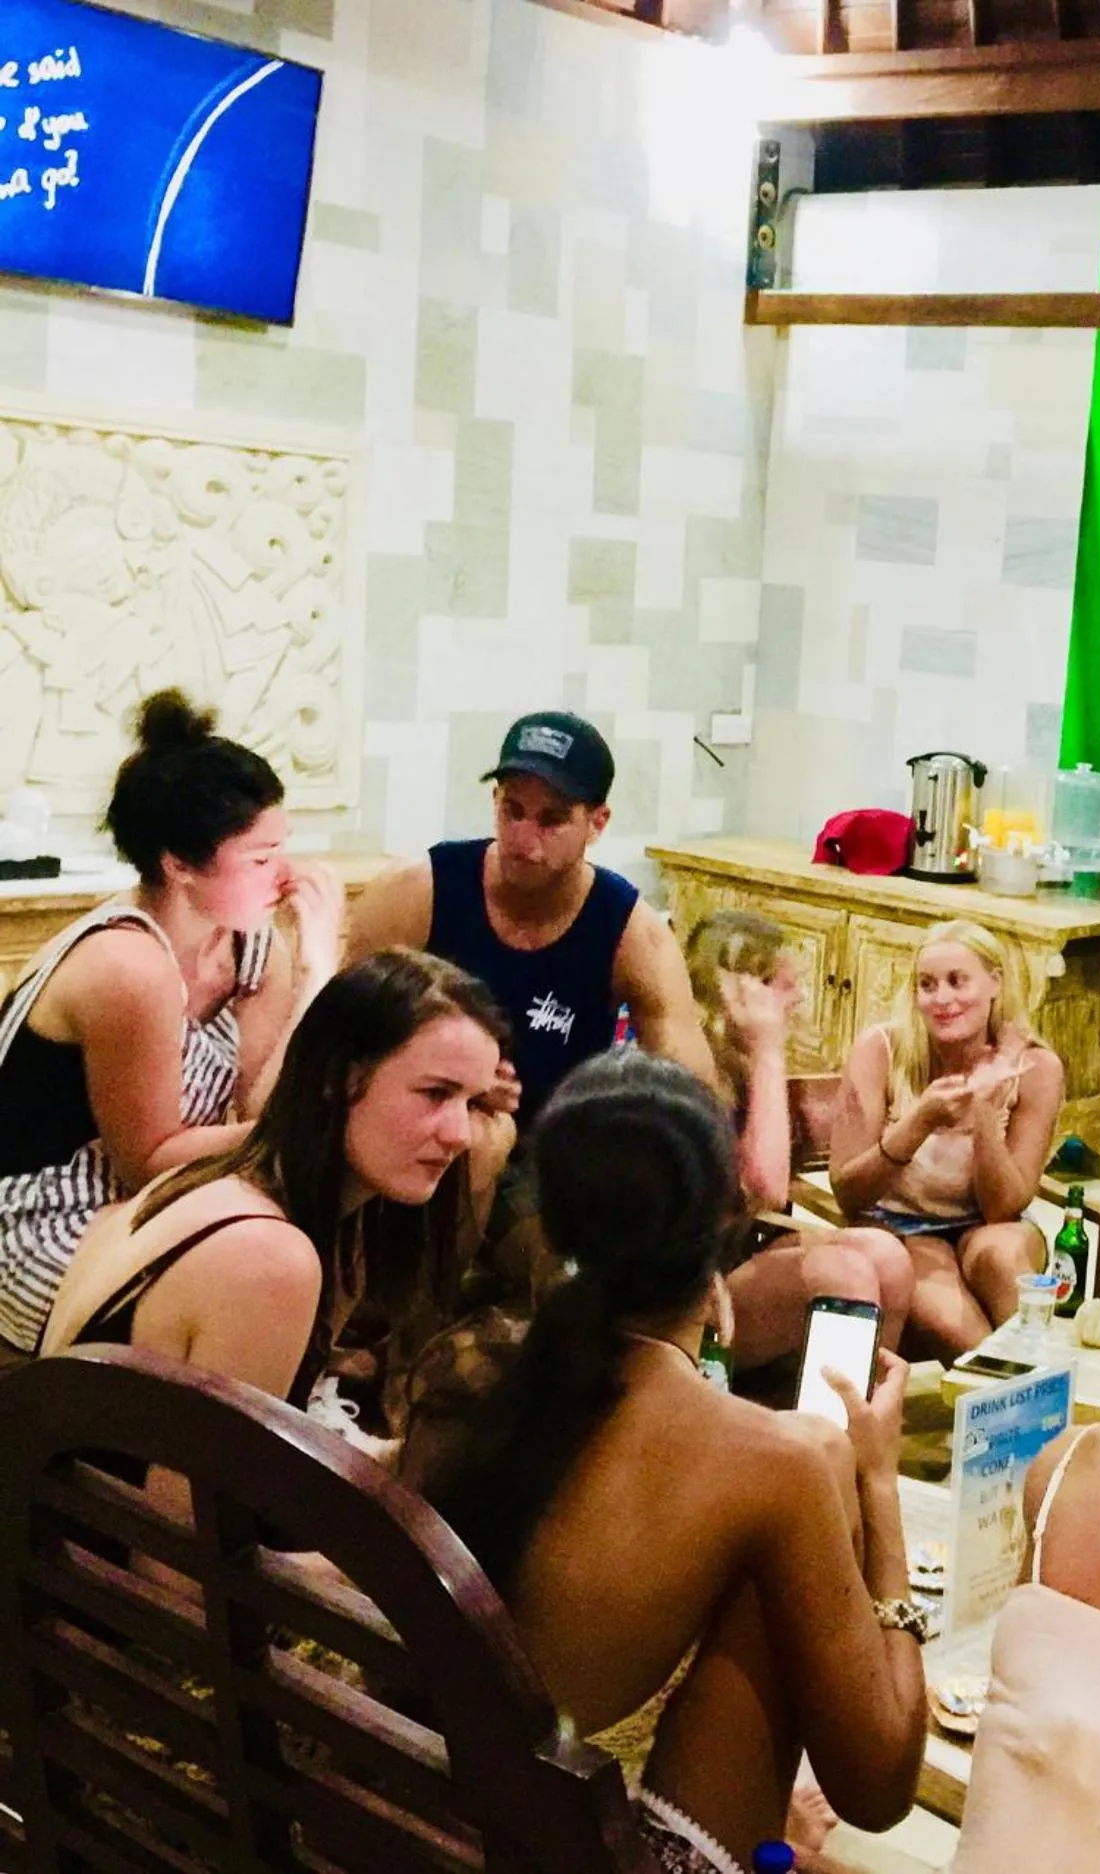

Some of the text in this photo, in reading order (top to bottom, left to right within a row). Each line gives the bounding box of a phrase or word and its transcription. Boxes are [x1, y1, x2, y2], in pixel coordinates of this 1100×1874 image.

[28, 46, 82, 84] said
[970, 1396, 1007, 1420] DRINK
[1009, 1386, 1032, 1407] LIST
